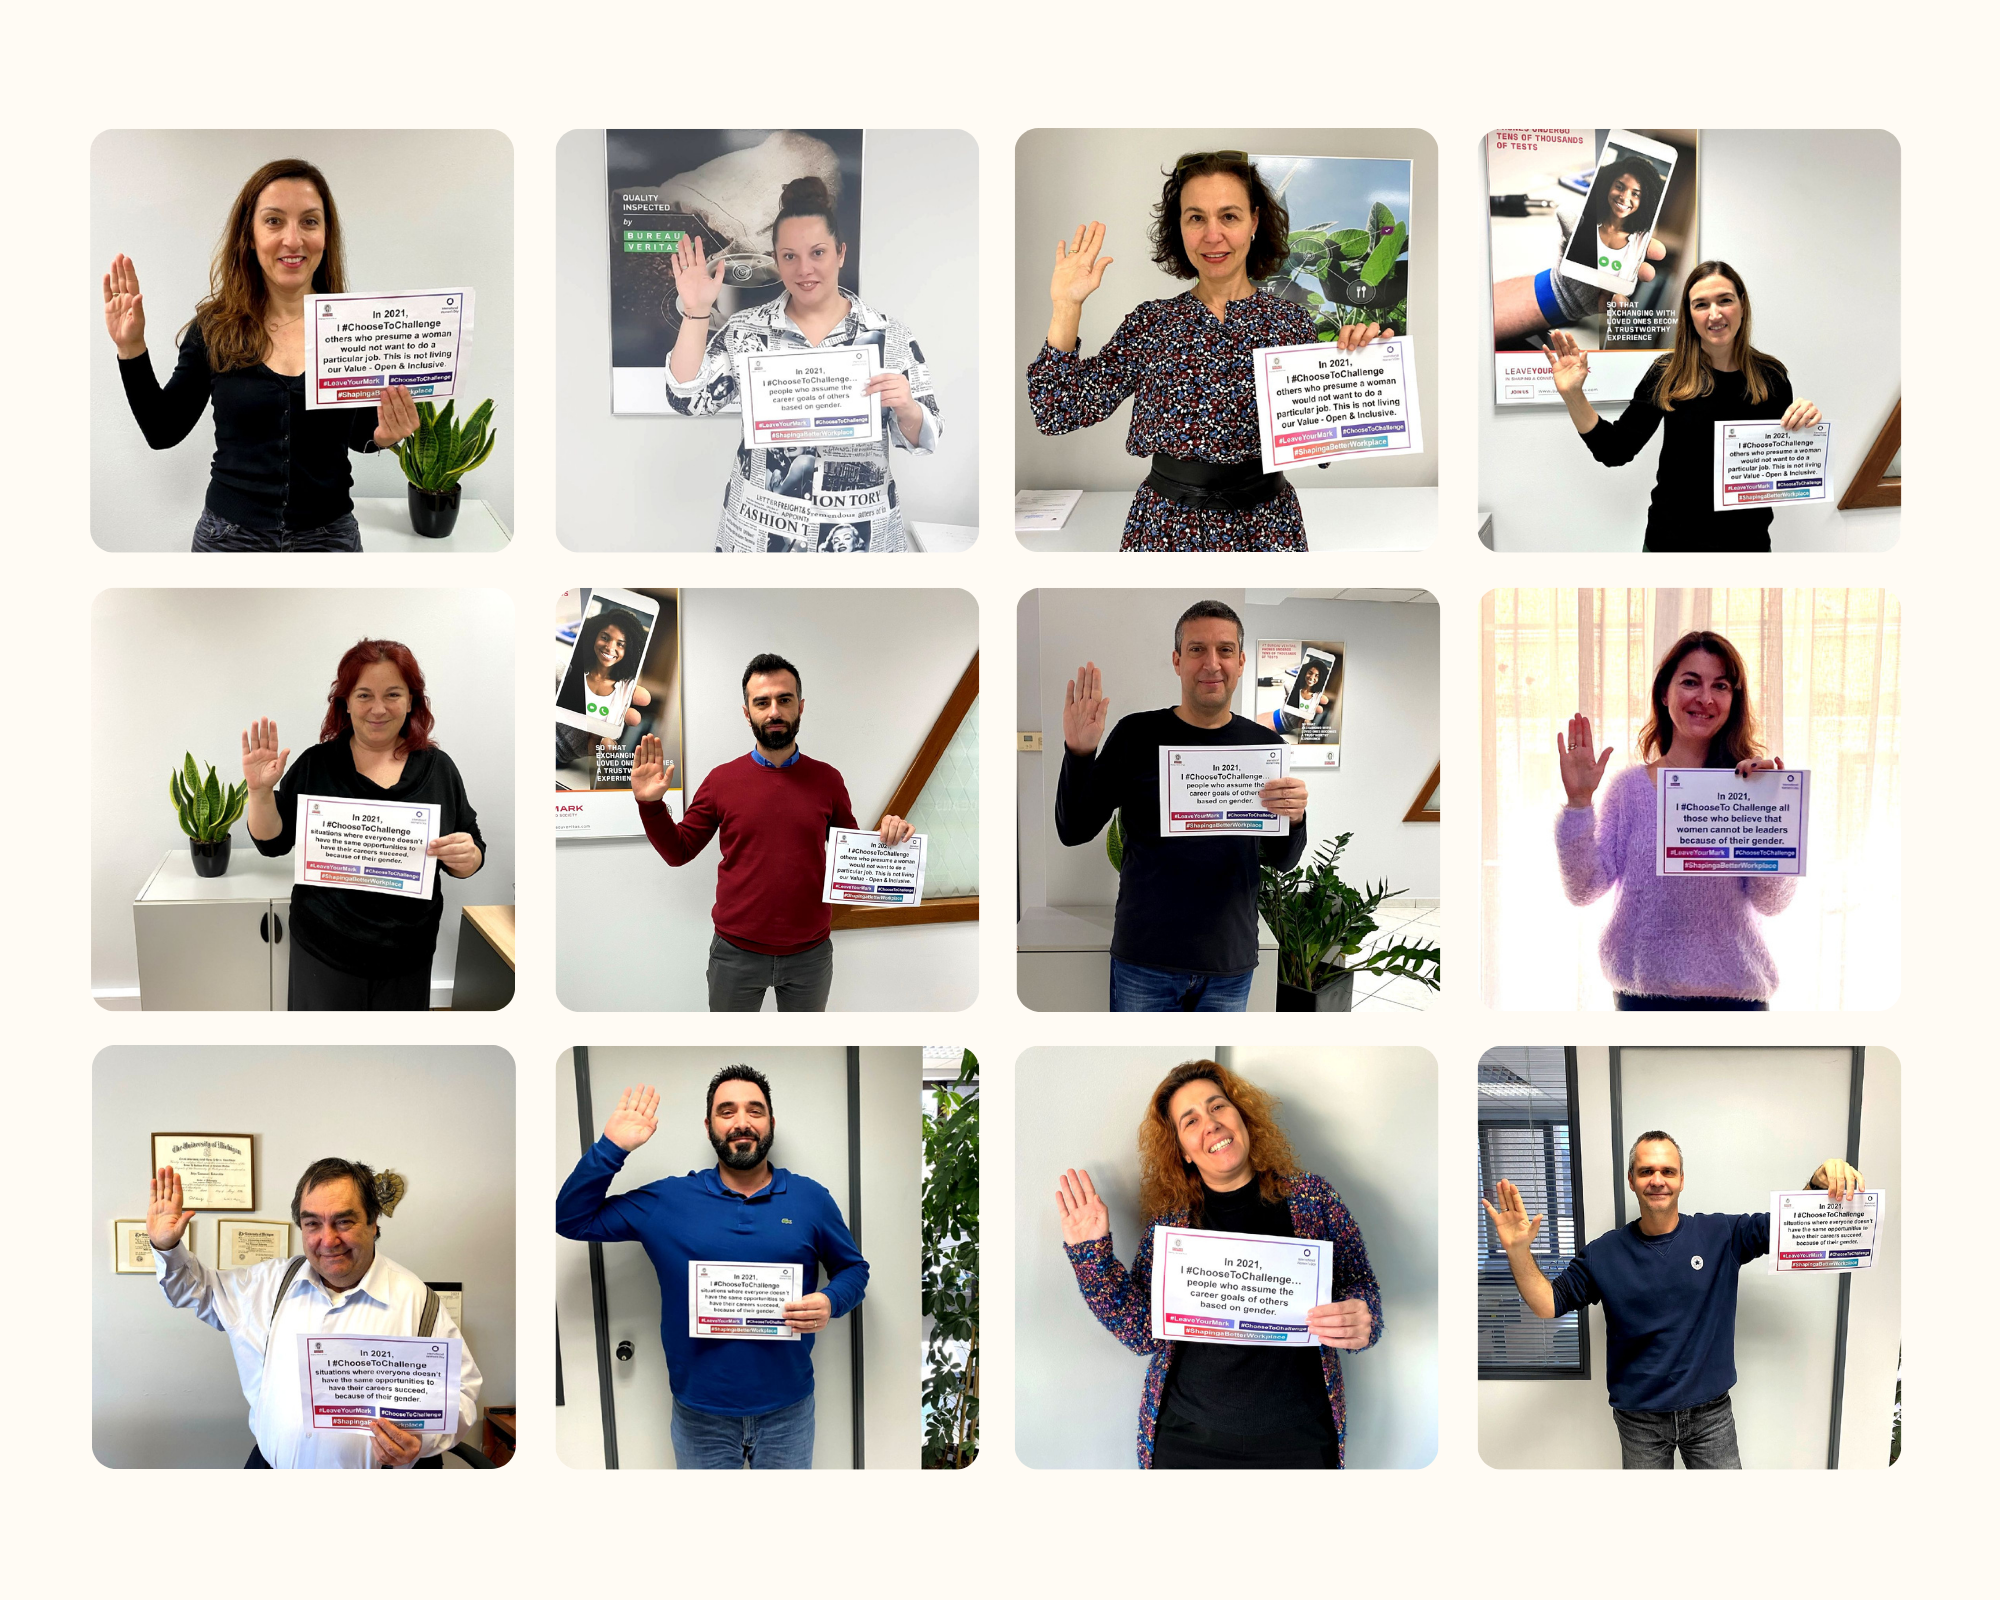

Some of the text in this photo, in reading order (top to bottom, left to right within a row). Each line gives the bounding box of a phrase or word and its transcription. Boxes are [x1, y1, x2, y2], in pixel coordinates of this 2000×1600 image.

[1535, 135, 1583, 144] THOUSANDS
[384, 309, 408, 318] 2021,
[342, 321, 441, 331] #ChooseToChallenge
[1330, 359, 1353, 367] 2021,
[1292, 368, 1384, 382] #ChooseToChallenge
[1277, 386, 1302, 396] others
[1304, 384, 1320, 392] who
[1323, 382, 1358, 391] presume
[1292, 396, 1316, 404] would
[1365, 389, 1375, 397] do
[1277, 407, 1314, 420] particular
[1316, 406, 1331, 414] job.
[1333, 403, 1350, 411] This
[1378, 398, 1400, 407] living
[1297, 418, 1319, 426] Value
[1326, 414, 1347, 423] Open
[1358, 410, 1397, 418] Inclusive.
[1279, 424, 1404, 444] #LeaveYourMark #ChooseToChallenge
[1294, 438, 1386, 456] #ShapingaBetterWorkplace
[740, 503, 798, 533] FASHION
[1728, 793, 1750, 801] 2021,
[1733, 804, 1776, 813] Challenge
[362, 815, 383, 824] 2021,
[327, 822, 410, 835] #ChooseToChallenge
[1752, 837, 1784, 846] gender.
[1224, 1258, 1262, 1269] In 2021,
[1187, 1266, 1301, 1285] #ChooseToChallenge...
[714, 1281, 779, 1289] #ChooseToChallenge
[1187, 1279, 1217, 1289] people
[1241, 1286, 1277, 1295] assume
[1190, 1290, 1218, 1299] career
[1221, 1294, 1245, 1302] goals
[1259, 1297, 1288, 1306] others
[1201, 1301, 1226, 1310] based
[1243, 1306, 1276, 1315] gender.
[1170, 1316, 1307, 1331] #LeaveYourMark #ChooseToChallenge
[1186, 1328, 1286, 1340] #ShapingaBetterWorkplace
[333, 1360, 427, 1369] #ChooseToChallenge
[394, 1395, 421, 1403] gender.
